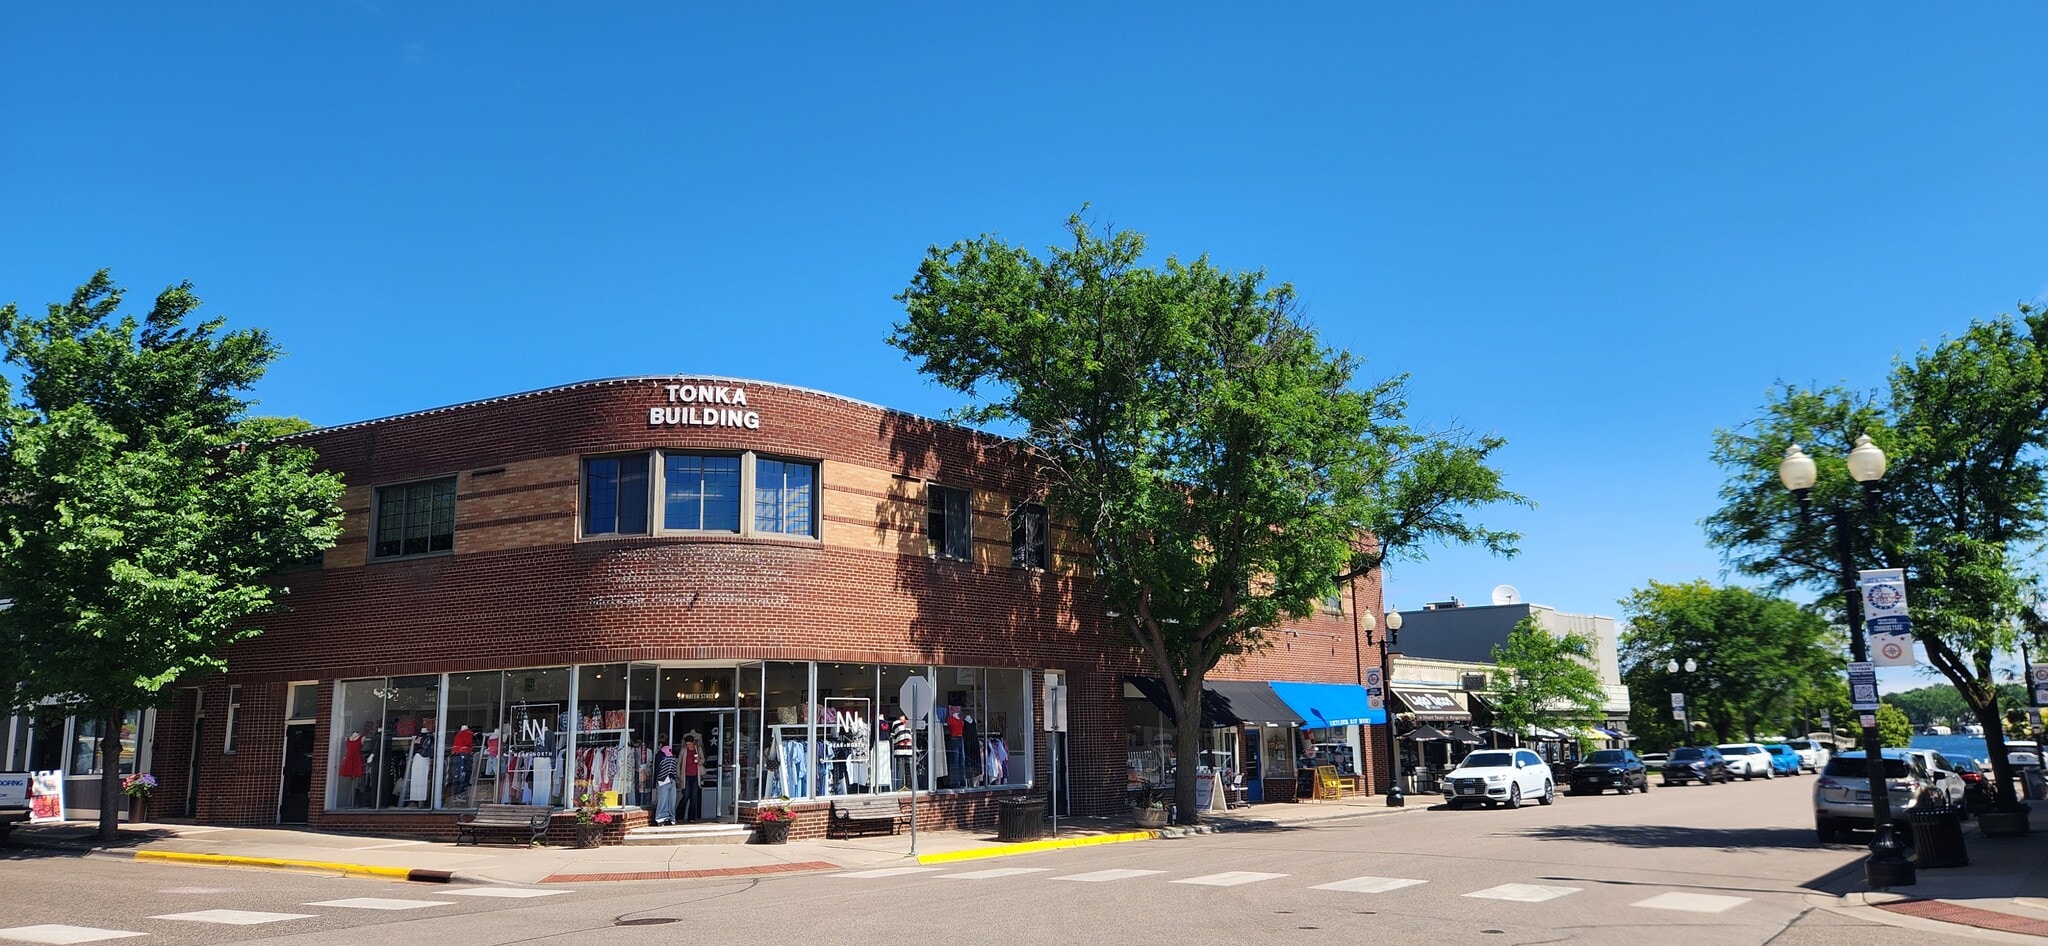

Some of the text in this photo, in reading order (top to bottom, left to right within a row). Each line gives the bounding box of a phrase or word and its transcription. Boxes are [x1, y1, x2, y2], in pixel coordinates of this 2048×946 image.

[665, 385, 747, 405] TONKA
[650, 407, 760, 429] BUILDING
[1423, 693, 1455, 707] Tacos
